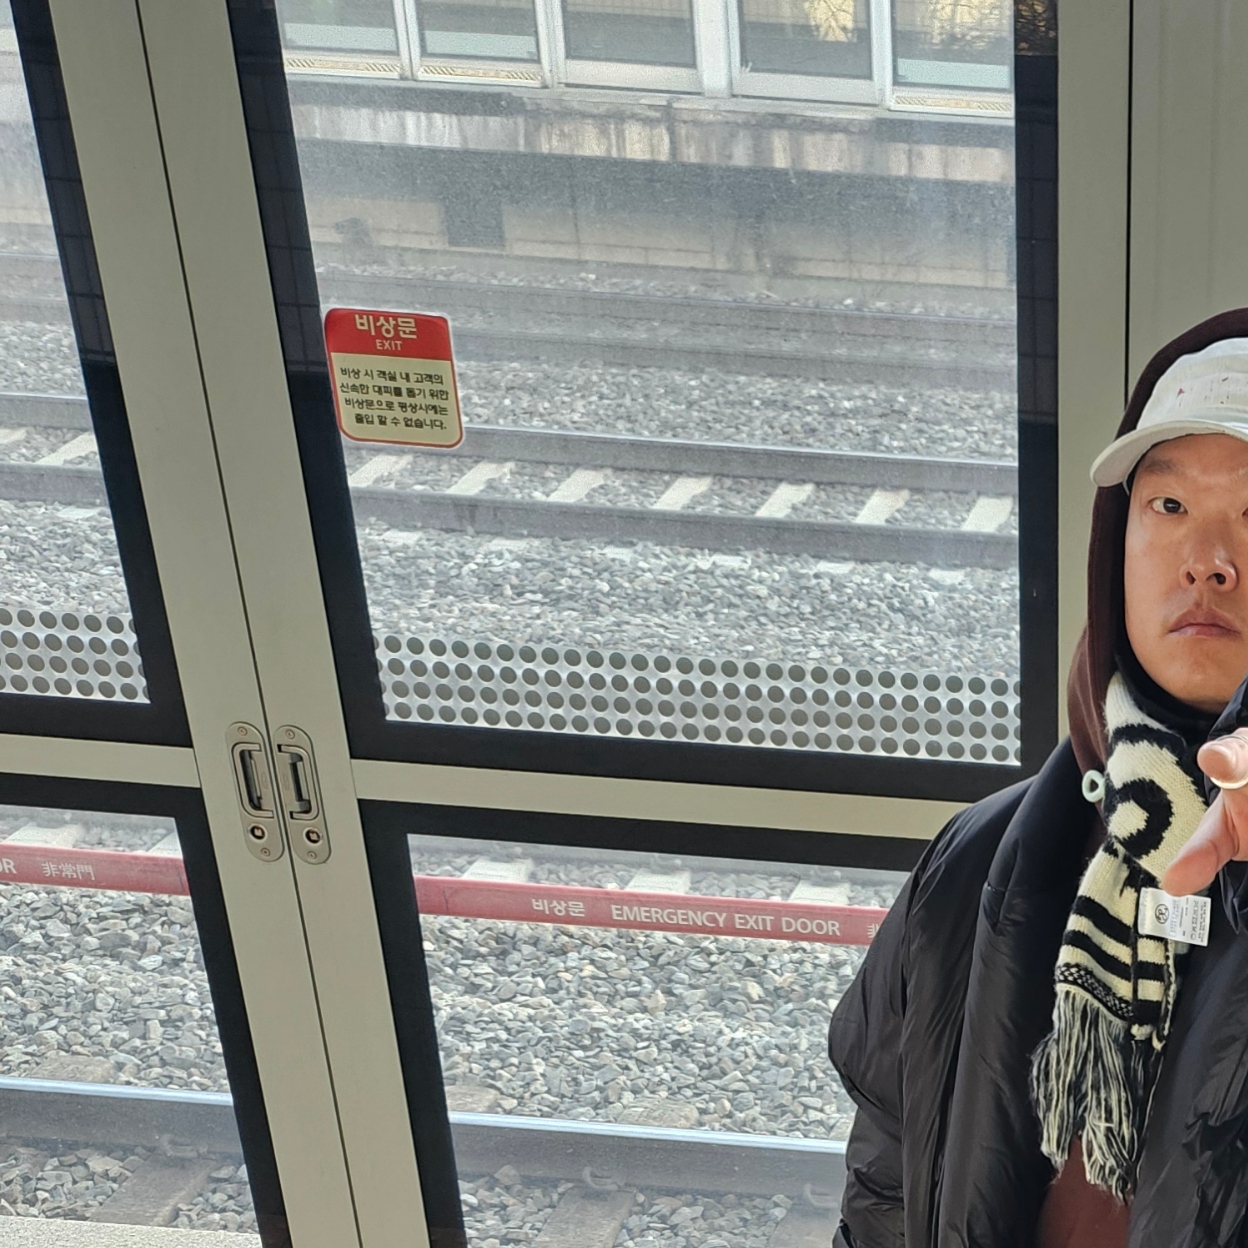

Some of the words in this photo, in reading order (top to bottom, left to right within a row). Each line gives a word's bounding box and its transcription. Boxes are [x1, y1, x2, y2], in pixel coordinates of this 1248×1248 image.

[355, 314, 417, 339] 비상문
[375, 339, 402, 351] EXIT
[340, 367, 361, 380] 비상
[364, 369, 374, 380] 시
[376, 369, 397, 382] 객실
[399, 371, 411, 383] 내
[413, 372, 444, 385] 고객의
[340, 382, 370, 395] 신속한
[372, 384, 403, 398] 대피를
[429, 388, 449, 401] 위한
[344, 397, 396, 411] 비상문으로
[398, 401, 449, 416] 평상시에는
[354, 413, 375, 425] 출입
[390, 416, 401, 427] 수
[41, 861, 95, 881] 非常門
[532, 898, 585, 917] 비상문
[611, 904, 727, 928] EMERGENCY
[734, 913, 775, 931] EXIT
[781, 916, 841, 936] DOOR
